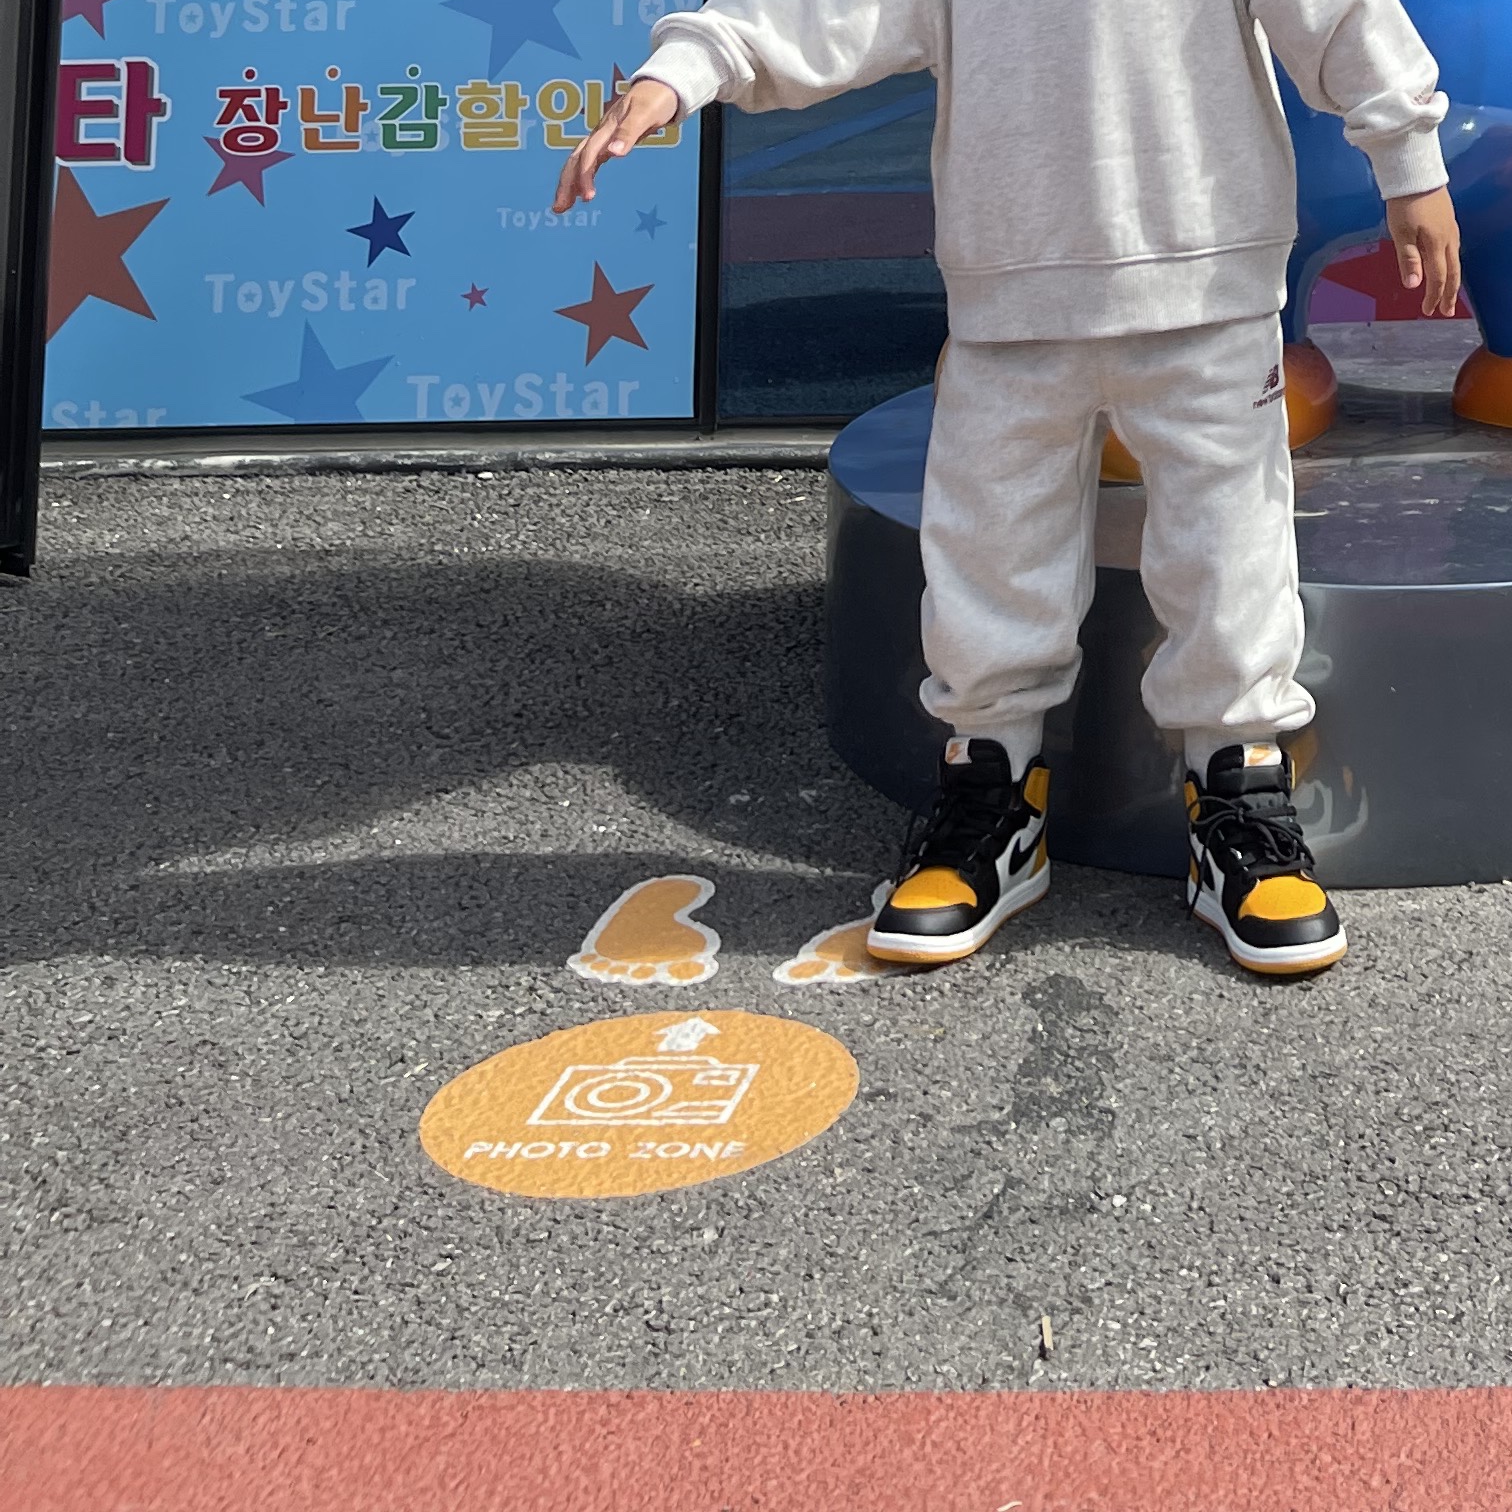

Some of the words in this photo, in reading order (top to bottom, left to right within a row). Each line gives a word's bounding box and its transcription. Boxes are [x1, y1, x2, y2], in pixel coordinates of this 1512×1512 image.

[497, 206, 602, 232] ToyStar
[205, 270, 417, 319] ToyStar
[406, 372, 640, 420] ToyStar
[463, 1140, 611, 1161] PHOTO
[629, 1140, 748, 1161] ZONE
